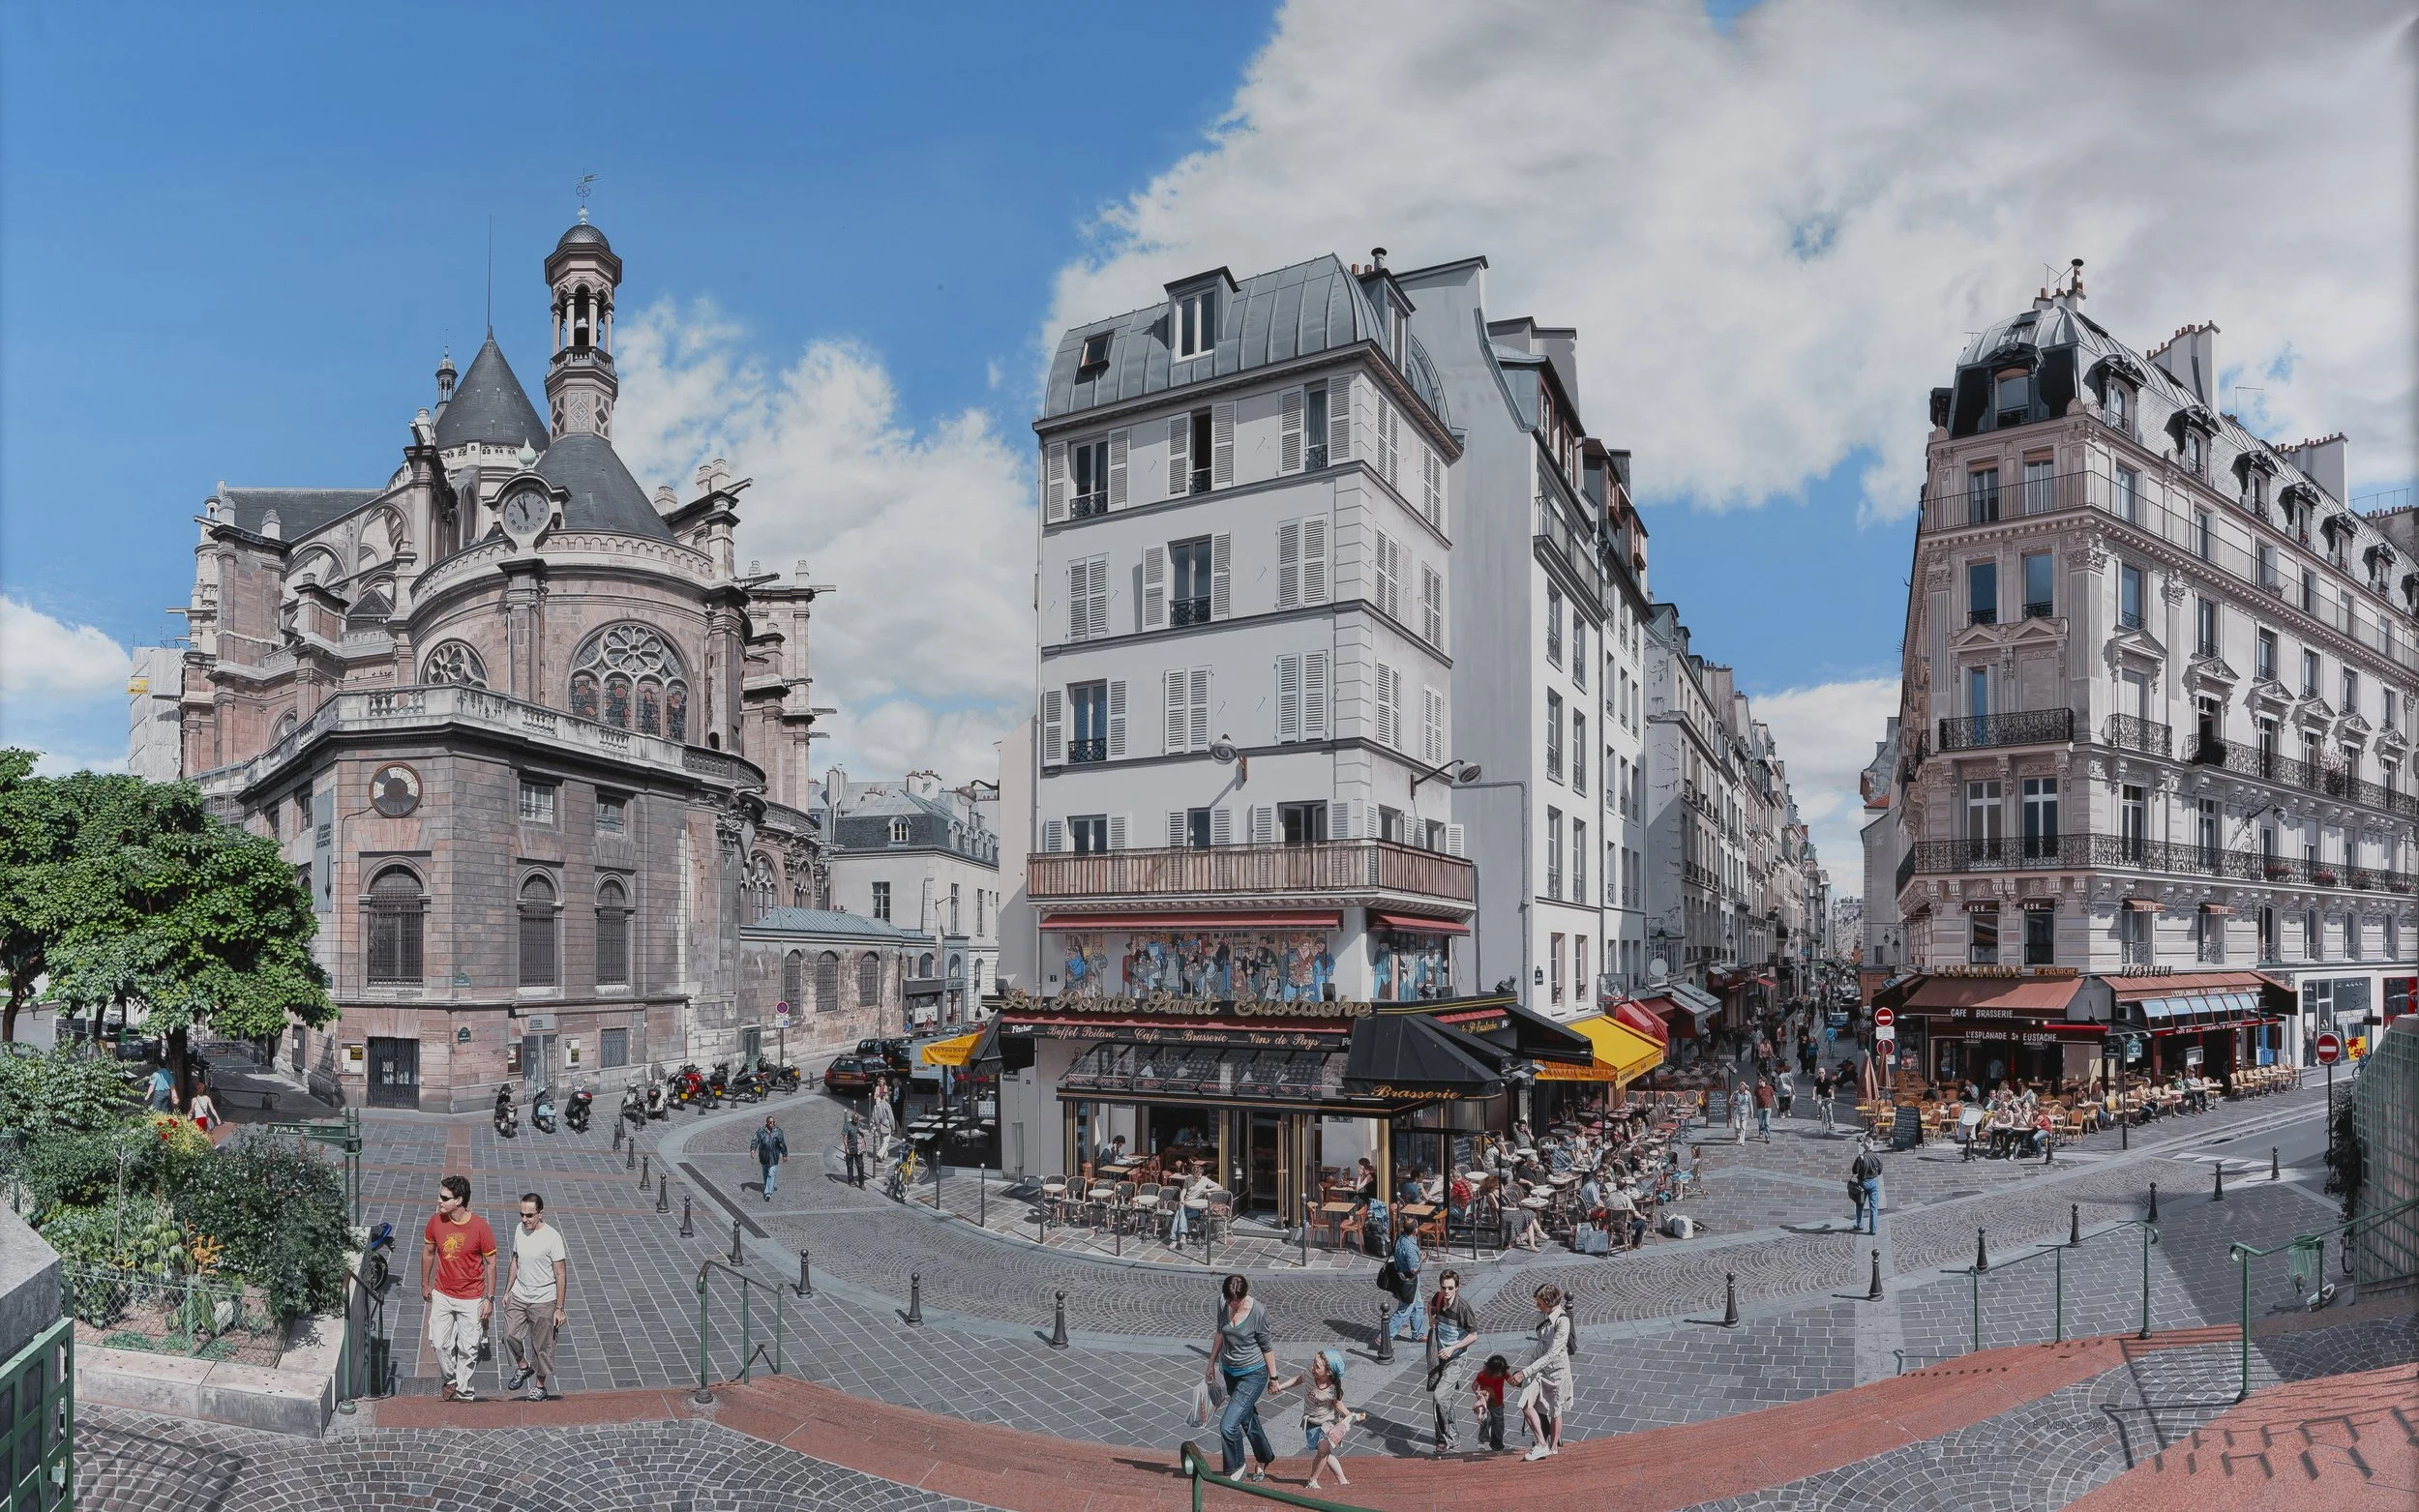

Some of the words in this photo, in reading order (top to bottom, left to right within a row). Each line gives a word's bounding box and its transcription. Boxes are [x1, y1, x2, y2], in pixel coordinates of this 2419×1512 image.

[1000, 988, 1043, 1010] La
[1050, 989, 1136, 1012] Pointe
[1143, 991, 1219, 1015] Saint
[1235, 992, 1372, 1018] Eustache
[1976, 1010, 2013, 1019] BRASSERIE
[1011, 1024, 1033, 1033] Fischer
[1181, 1029, 1229, 1042] Brasserie
[1247, 1032, 1270, 1045] Vins
[1274, 1033, 1288, 1045] de
[1292, 1034, 1320, 1050] Pays
[1965, 1030, 2007, 1041] L'ESPLANADE
[2022, 1032, 2057, 1042] EUSTACHE
[1371, 1085, 1462, 1100] Brasserie
